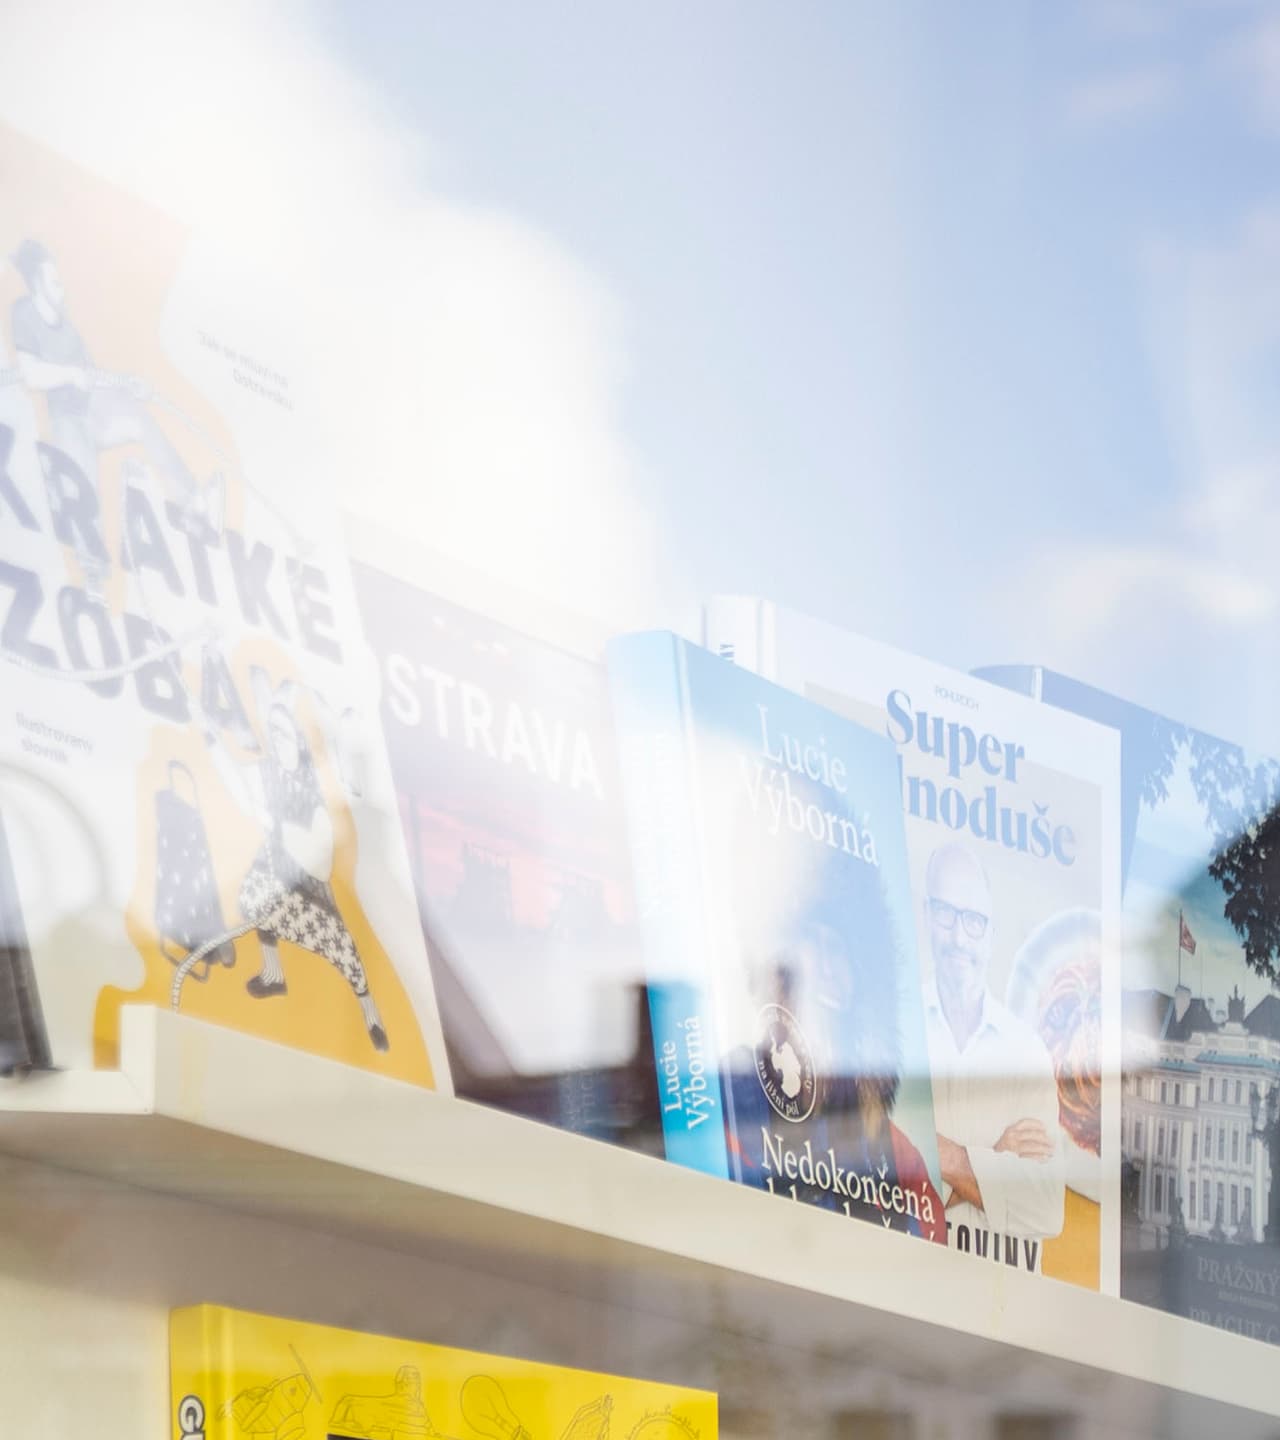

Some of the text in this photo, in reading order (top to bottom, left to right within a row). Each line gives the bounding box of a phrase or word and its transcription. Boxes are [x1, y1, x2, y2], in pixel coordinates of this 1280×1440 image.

[760, 704, 848, 795] Lucie
[886, 689, 1025, 784] Super
[738, 755, 880, 869] Výborná
[663, 1040, 682, 1114] Lucie
[687, 1014, 715, 1130] Výborná
[761, 1126, 935, 1225] Nedokončená
